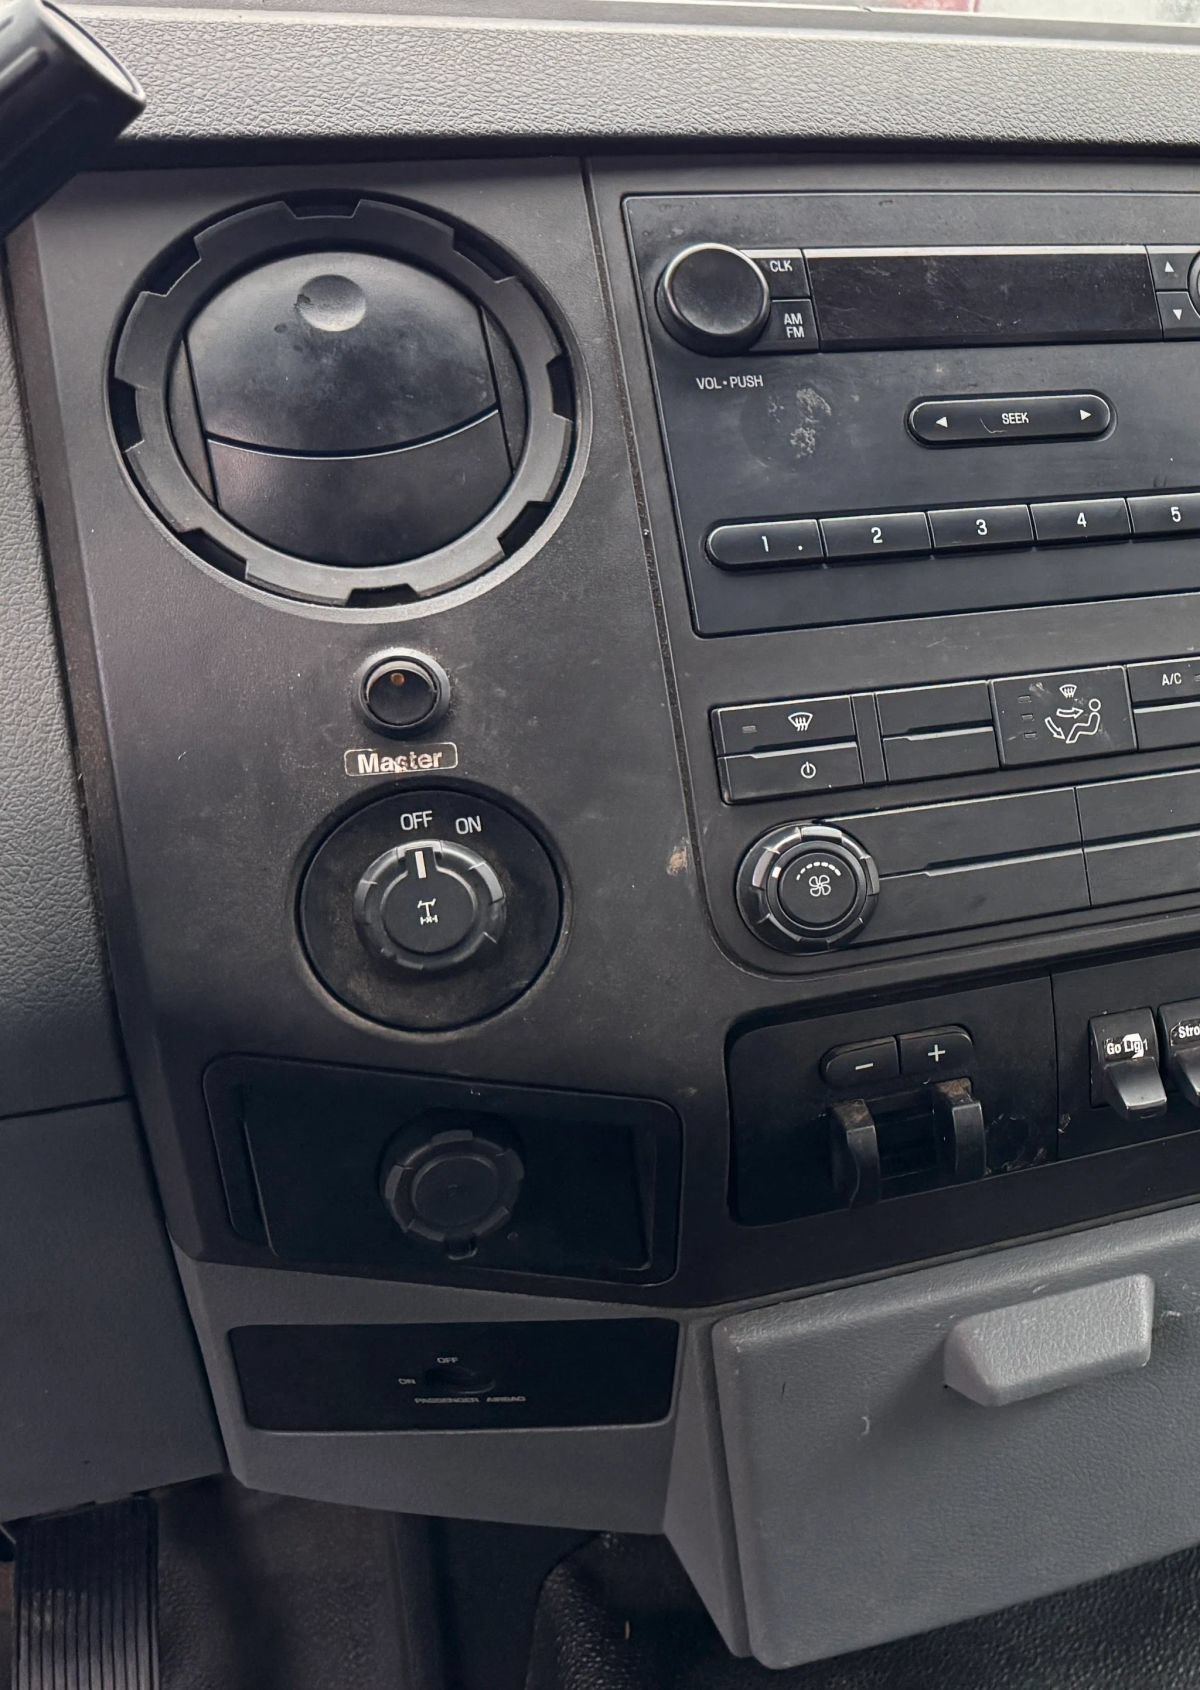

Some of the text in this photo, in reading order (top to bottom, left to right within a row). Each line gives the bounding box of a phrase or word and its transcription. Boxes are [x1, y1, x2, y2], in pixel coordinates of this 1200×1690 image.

[770, 260, 793, 272] CLK
[784, 313, 802, 325] AM
[787, 326, 805, 338] FM
[1001, 412, 1029, 425] SEEK
[1077, 512, 1087, 528] 4
[1170, 506, 1182, 522] 5
[871, 527, 883, 544] 2
[976, 519, 988, 536] 3
[761, 535, 769, 553] 1
[1161, 672, 1182, 686] A/C
[357, 751, 443, 774] Master
[400, 811, 433, 831] OFF
[455, 815, 482, 834] ON
[1106, 1042, 1122, 1055] Go
